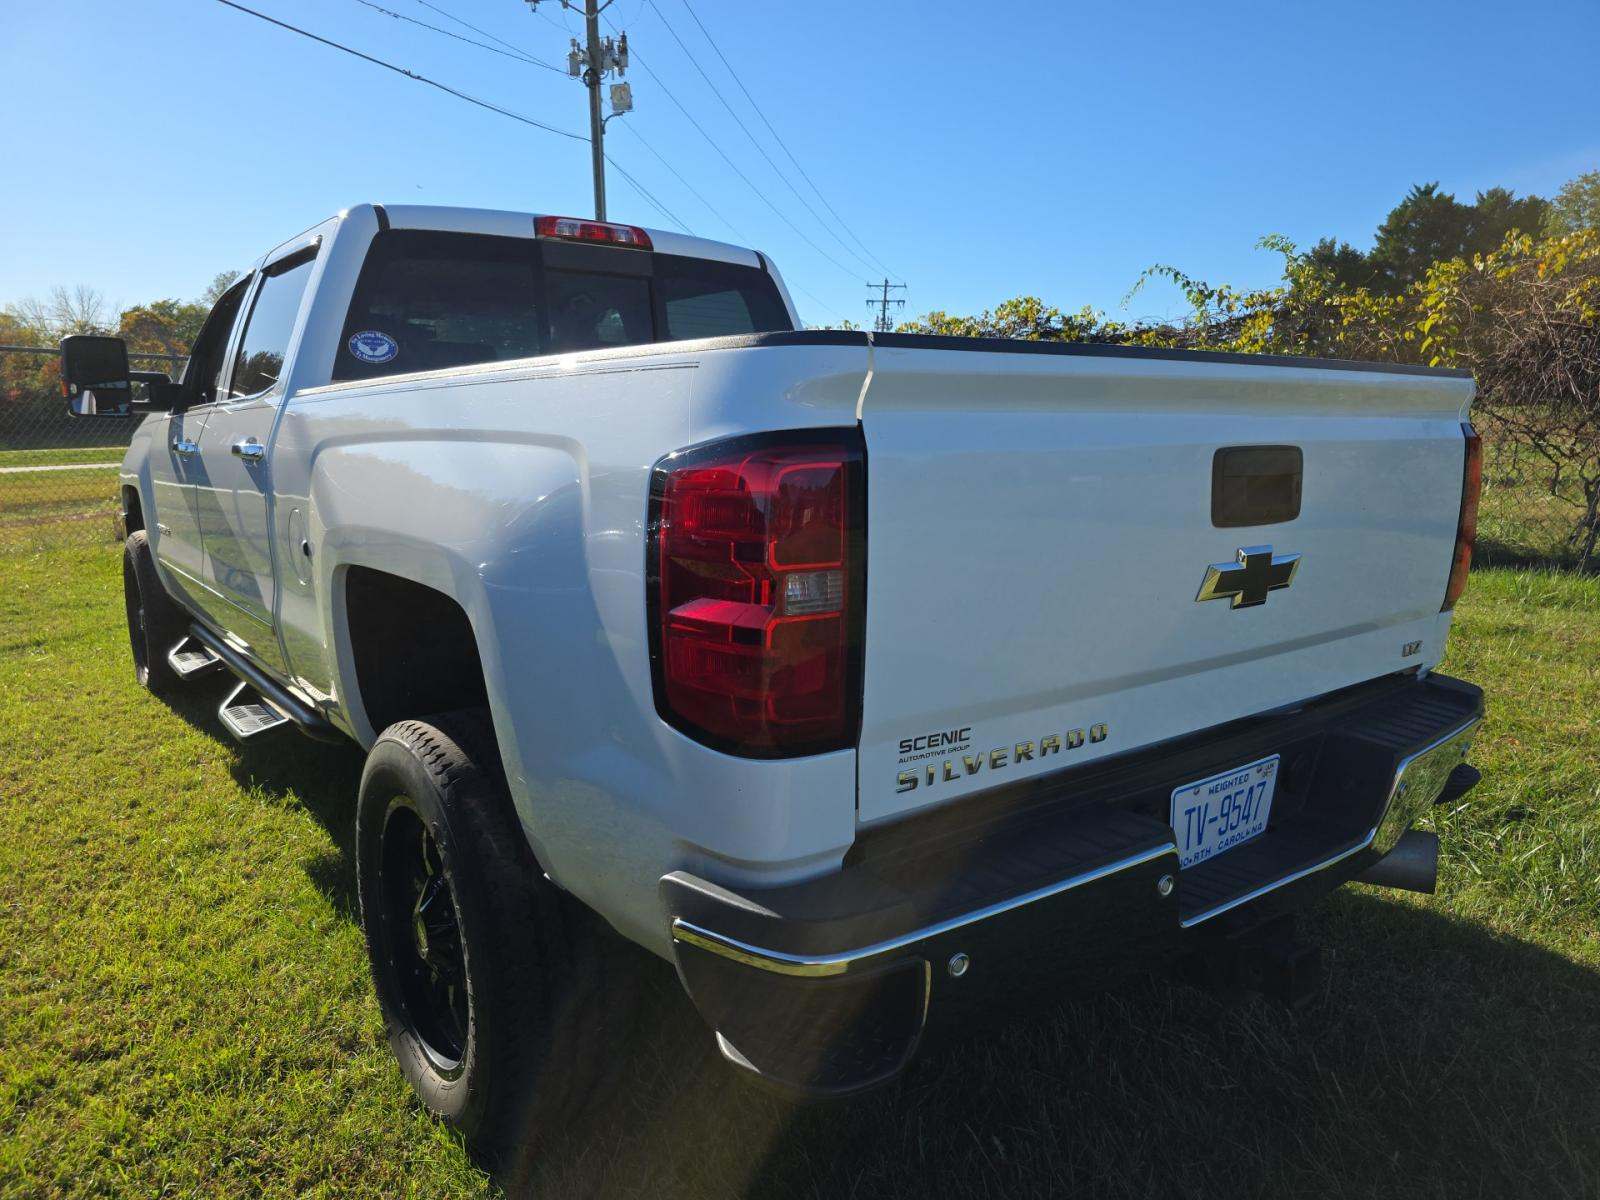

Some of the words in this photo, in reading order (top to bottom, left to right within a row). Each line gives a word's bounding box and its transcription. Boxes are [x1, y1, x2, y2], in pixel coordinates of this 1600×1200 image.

[898, 749, 947, 764] AUTOMOTIVE
[947, 744, 971, 755] GROUP
[899, 727, 972, 754] SCENIC
[896, 722, 1109, 793] SILVERADO
[1208, 773, 1250, 796] WEIGHTED
[1184, 780, 1267, 851] TV-9547
